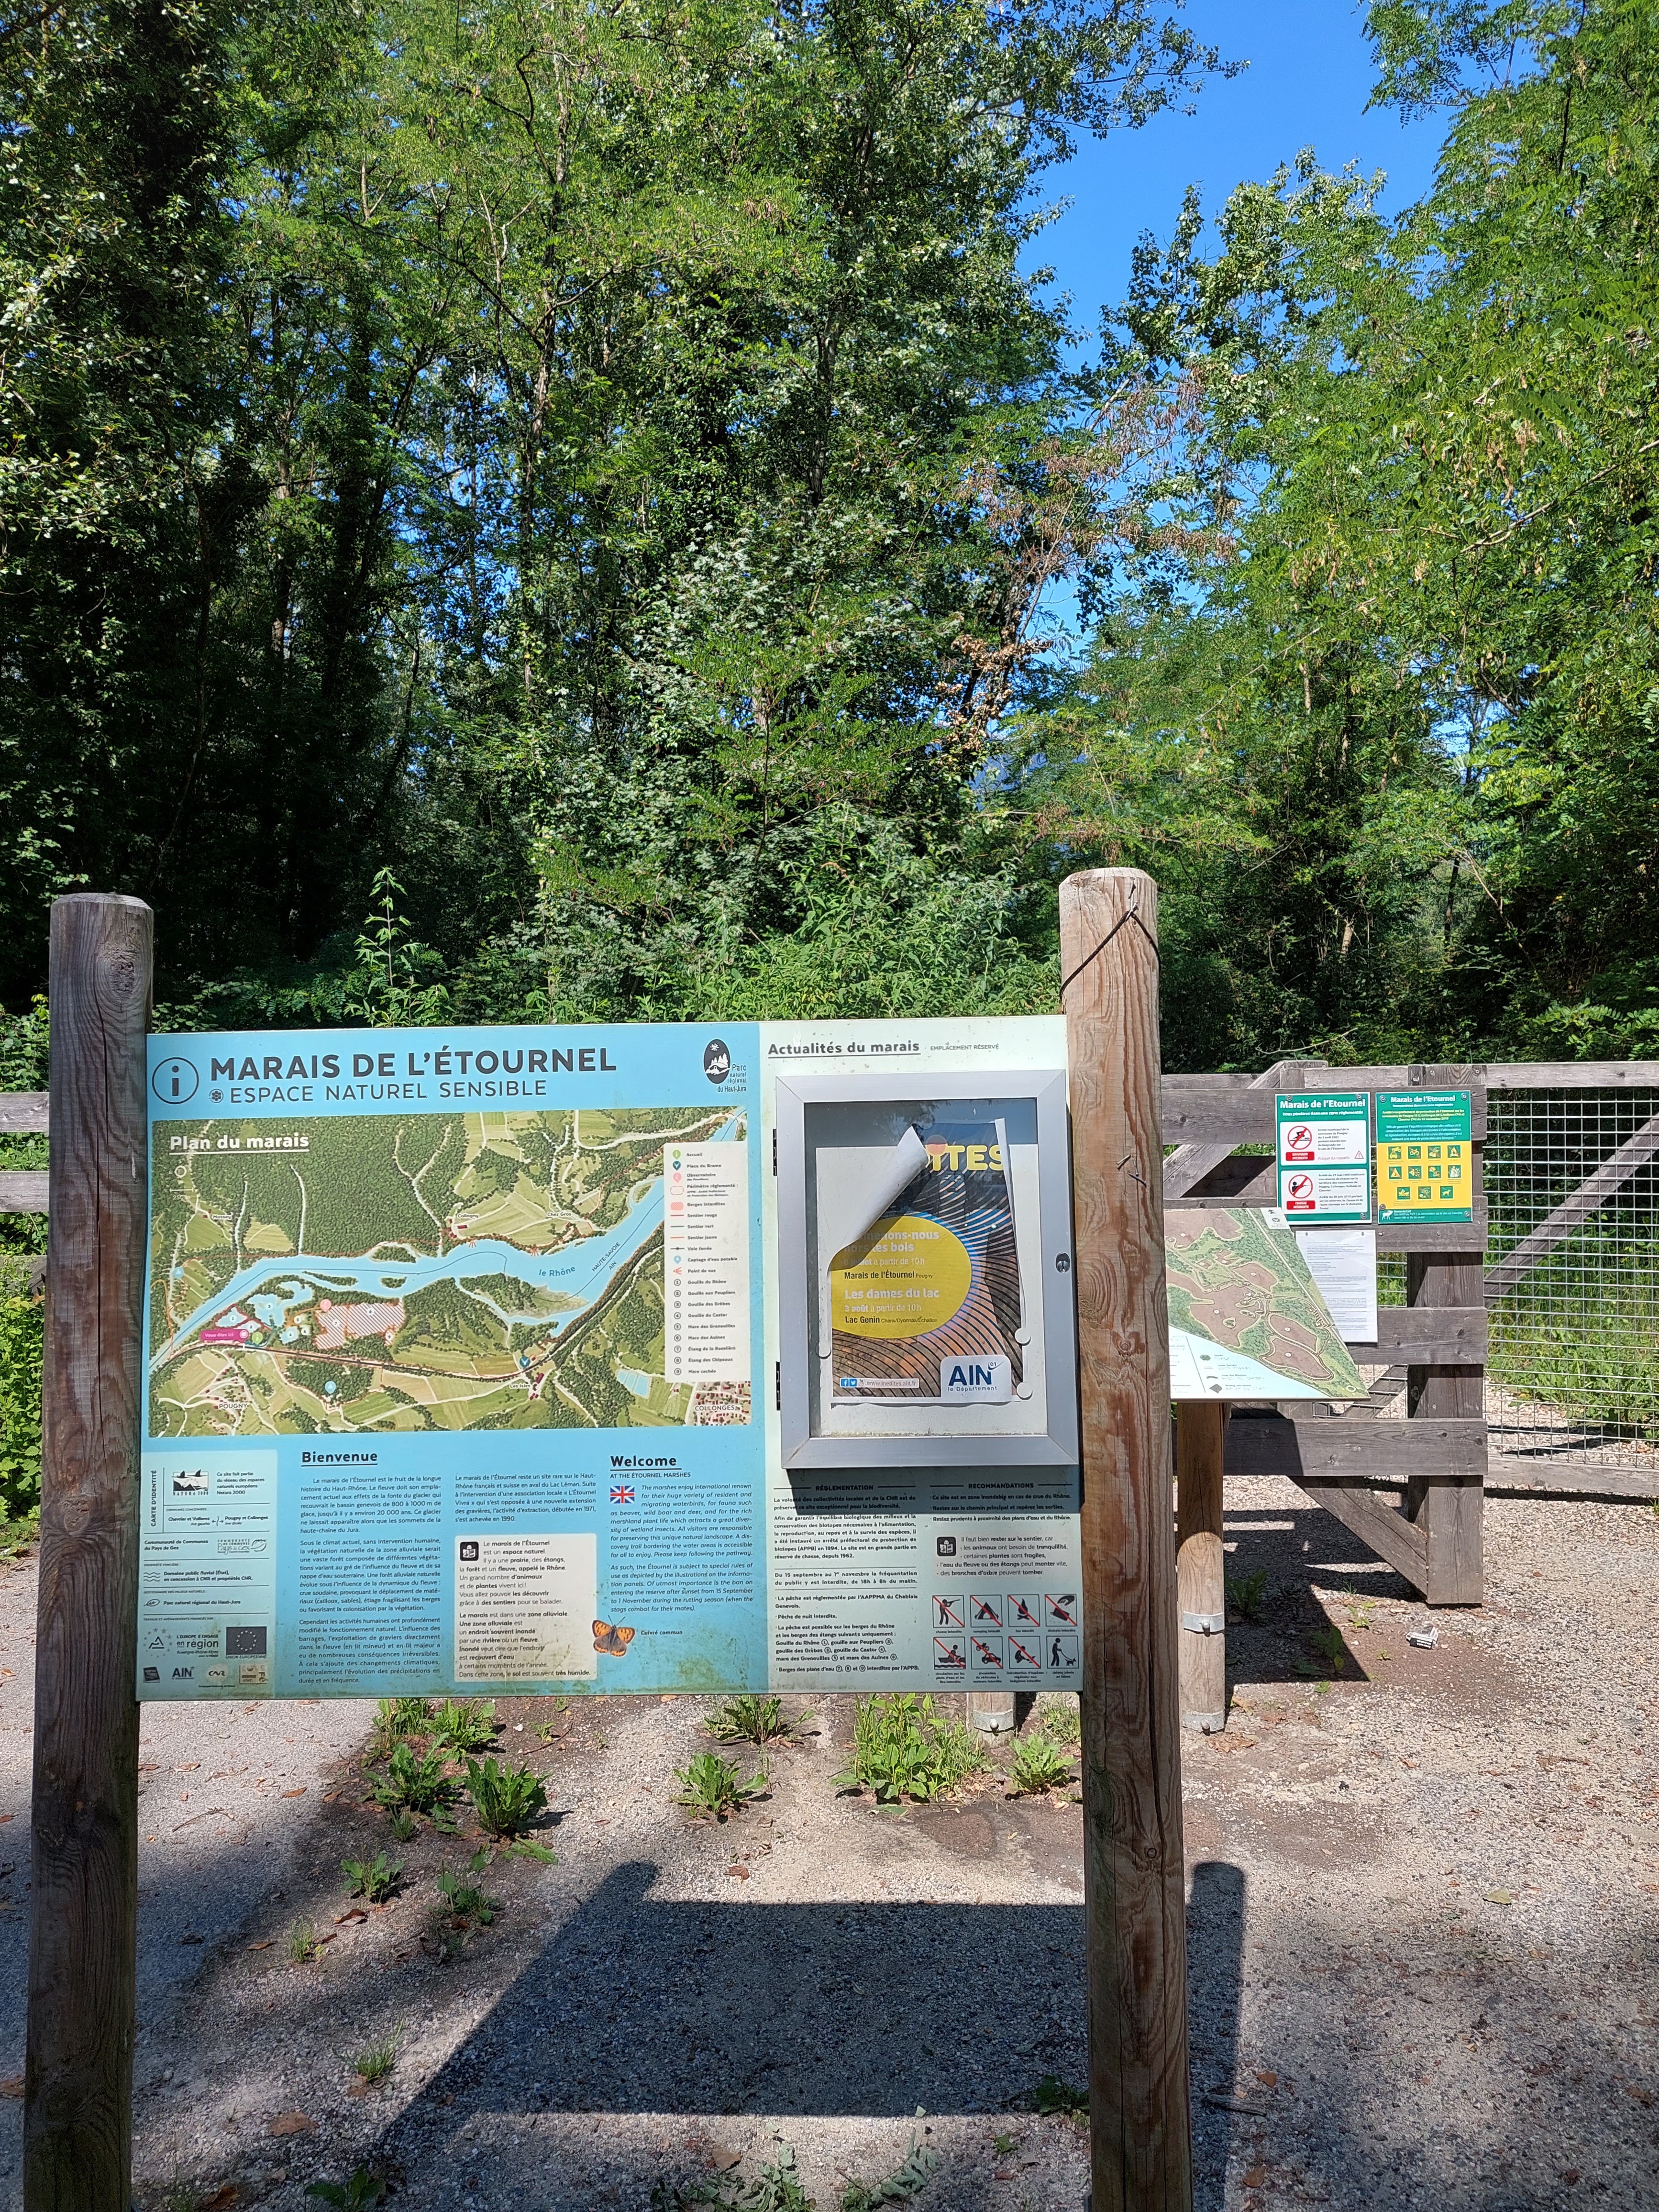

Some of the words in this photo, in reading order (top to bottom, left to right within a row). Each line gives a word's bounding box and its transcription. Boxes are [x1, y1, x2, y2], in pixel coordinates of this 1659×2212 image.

[768, 1042, 841, 1054] Actualités
[847, 1042, 864, 1052] du
[871, 1040, 919, 1052] marais
[211, 1054, 340, 1081] MARAIS
[353, 1053, 395, 1077] DE
[409, 1046, 616, 1075] L'ÉTOURNEL
[732, 1064, 746, 1073] Parc
[231, 1086, 313, 1103] ESPACE
[326, 1084, 427, 1100] NATUREL
[440, 1080, 546, 1097] SENSIBLE
[1280, 1100, 1309, 1108] Marais
[1324, 1099, 1365, 1107] l'Etournel
[170, 1136, 210, 1150] Plan
[217, 1135, 240, 1149] du
[246, 1132, 310, 1148] marais
[925, 1143, 1004, 1172] ITES
[872, 1243, 888, 1252] les
[891, 1242, 914, 1251] bois
[591, 1241, 621, 1272] HAUTE-SAVOIE
[608, 1261, 617, 1270] AIN
[550, 1267, 575, 1276] Rhône
[881, 1270, 914, 1278] l'Étournel
[845, 1290, 863, 1299] Les
[866, 1289, 903, 1298] dames
[906, 1288, 919, 1298] du
[923, 1288, 940, 1298] lac
[876, 1304, 895, 1313] partir
[949, 1365, 993, 1386] AIN
[302, 1451, 377, 1462] Bienvenue
[610, 1456, 676, 1467] Welcome
[187, 1639, 219, 1649] région
[172, 1668, 192, 1677] AIN
